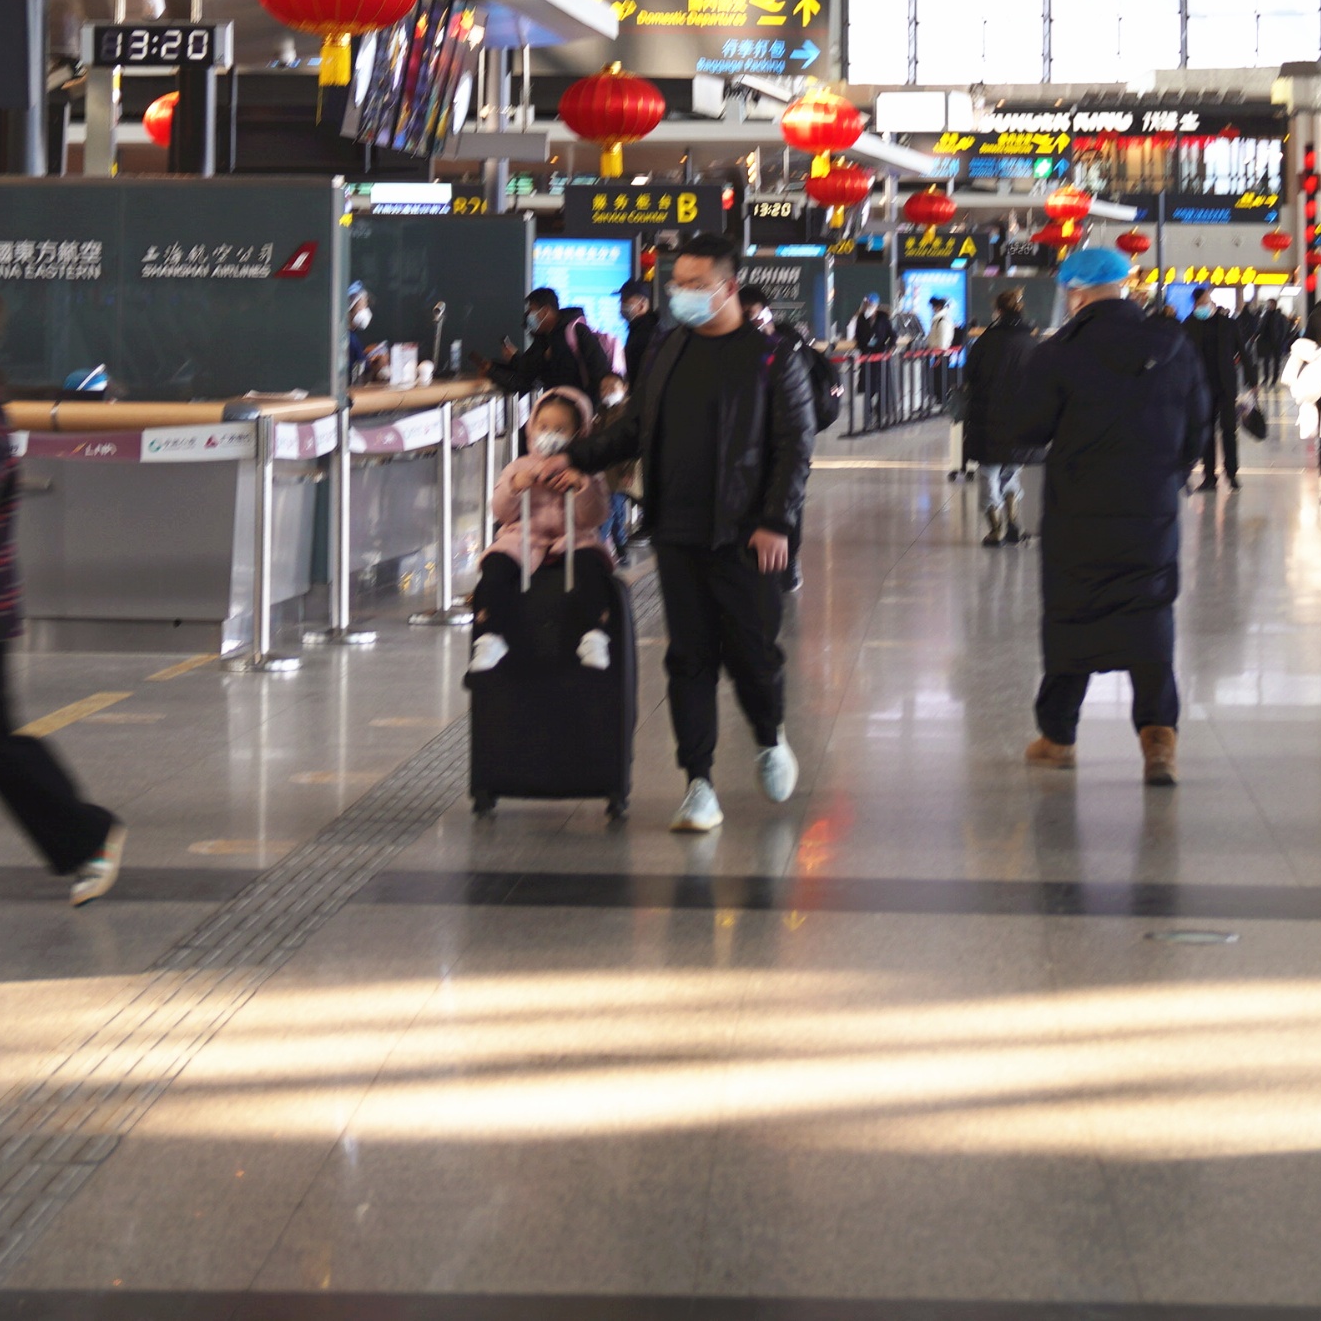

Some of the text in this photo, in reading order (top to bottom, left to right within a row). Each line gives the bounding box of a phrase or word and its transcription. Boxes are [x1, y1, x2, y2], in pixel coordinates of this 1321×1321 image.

[105, 30, 208, 59] 13:20
[678, 193, 697, 223] B
[24, 265, 102, 279] EASTERN
[141, 264, 271, 278] SHANGHAI AIRLINES
